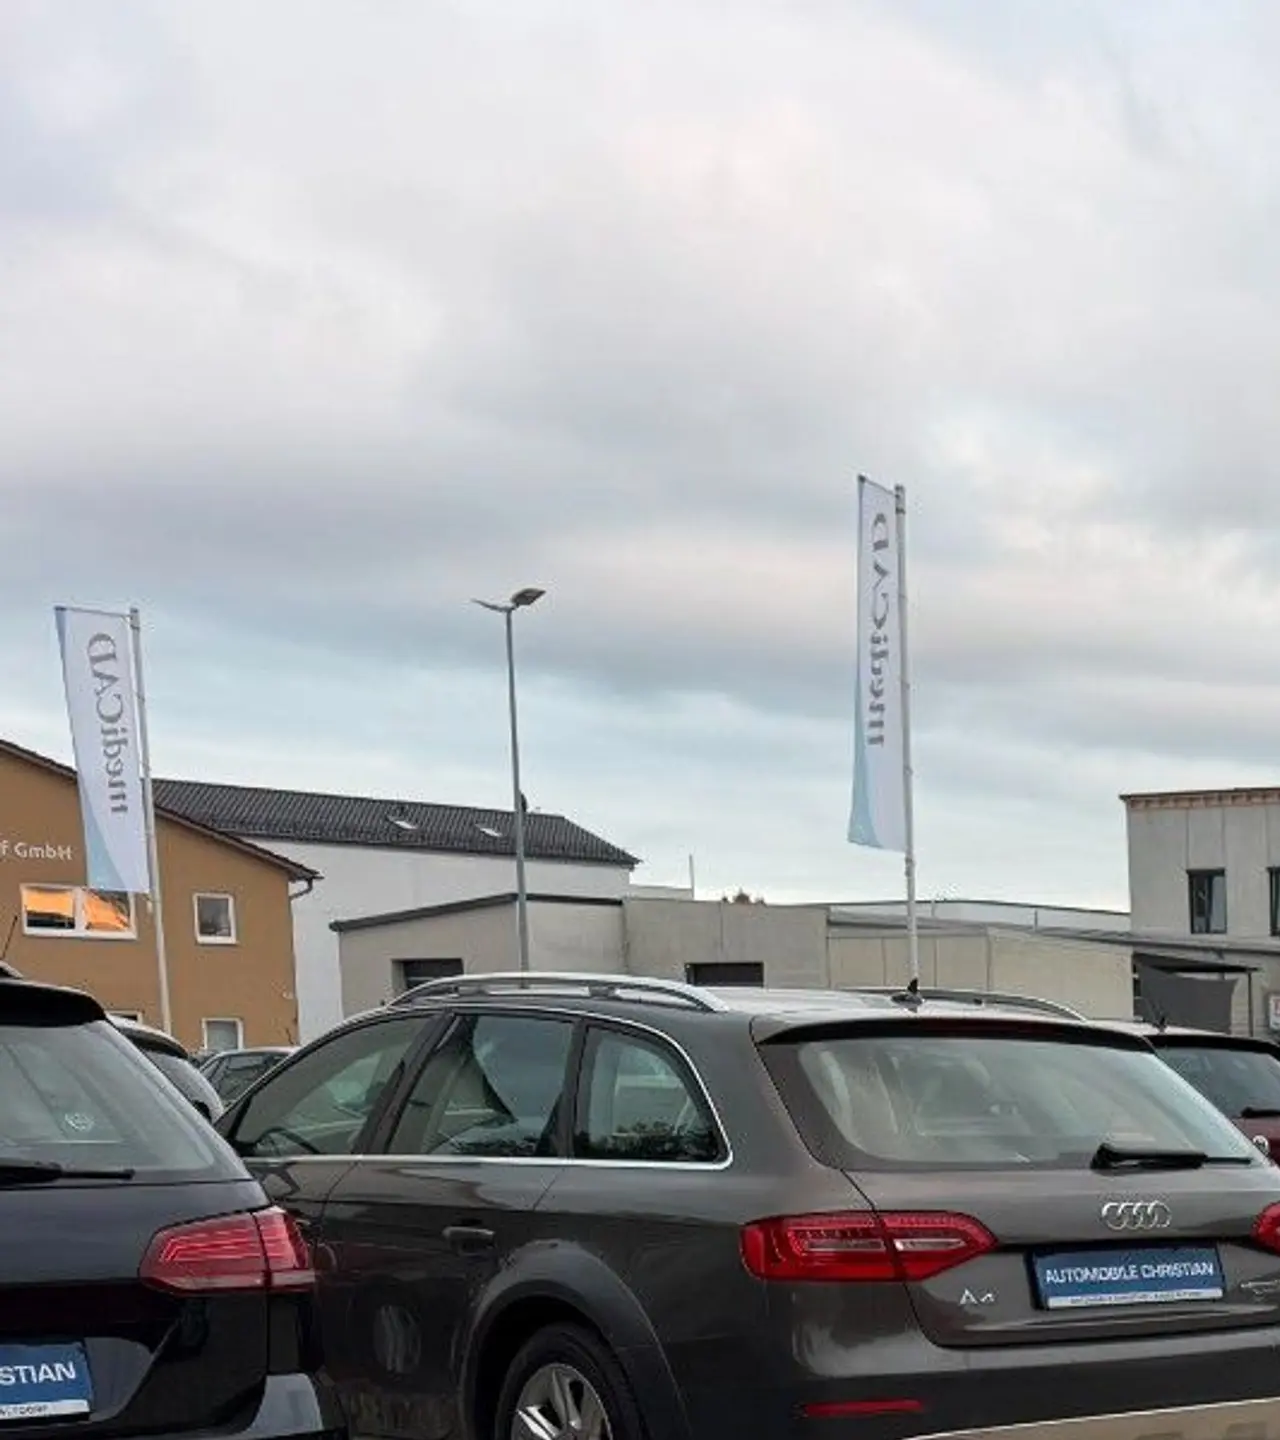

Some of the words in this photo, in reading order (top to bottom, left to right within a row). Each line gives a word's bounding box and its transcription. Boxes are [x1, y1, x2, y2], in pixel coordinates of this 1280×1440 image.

[13, 841, 73, 861] GmbH
[1046, 1264, 1139, 1284] AUTOMOBILE
[1141, 1261, 1214, 1280] CHRISTIAN
